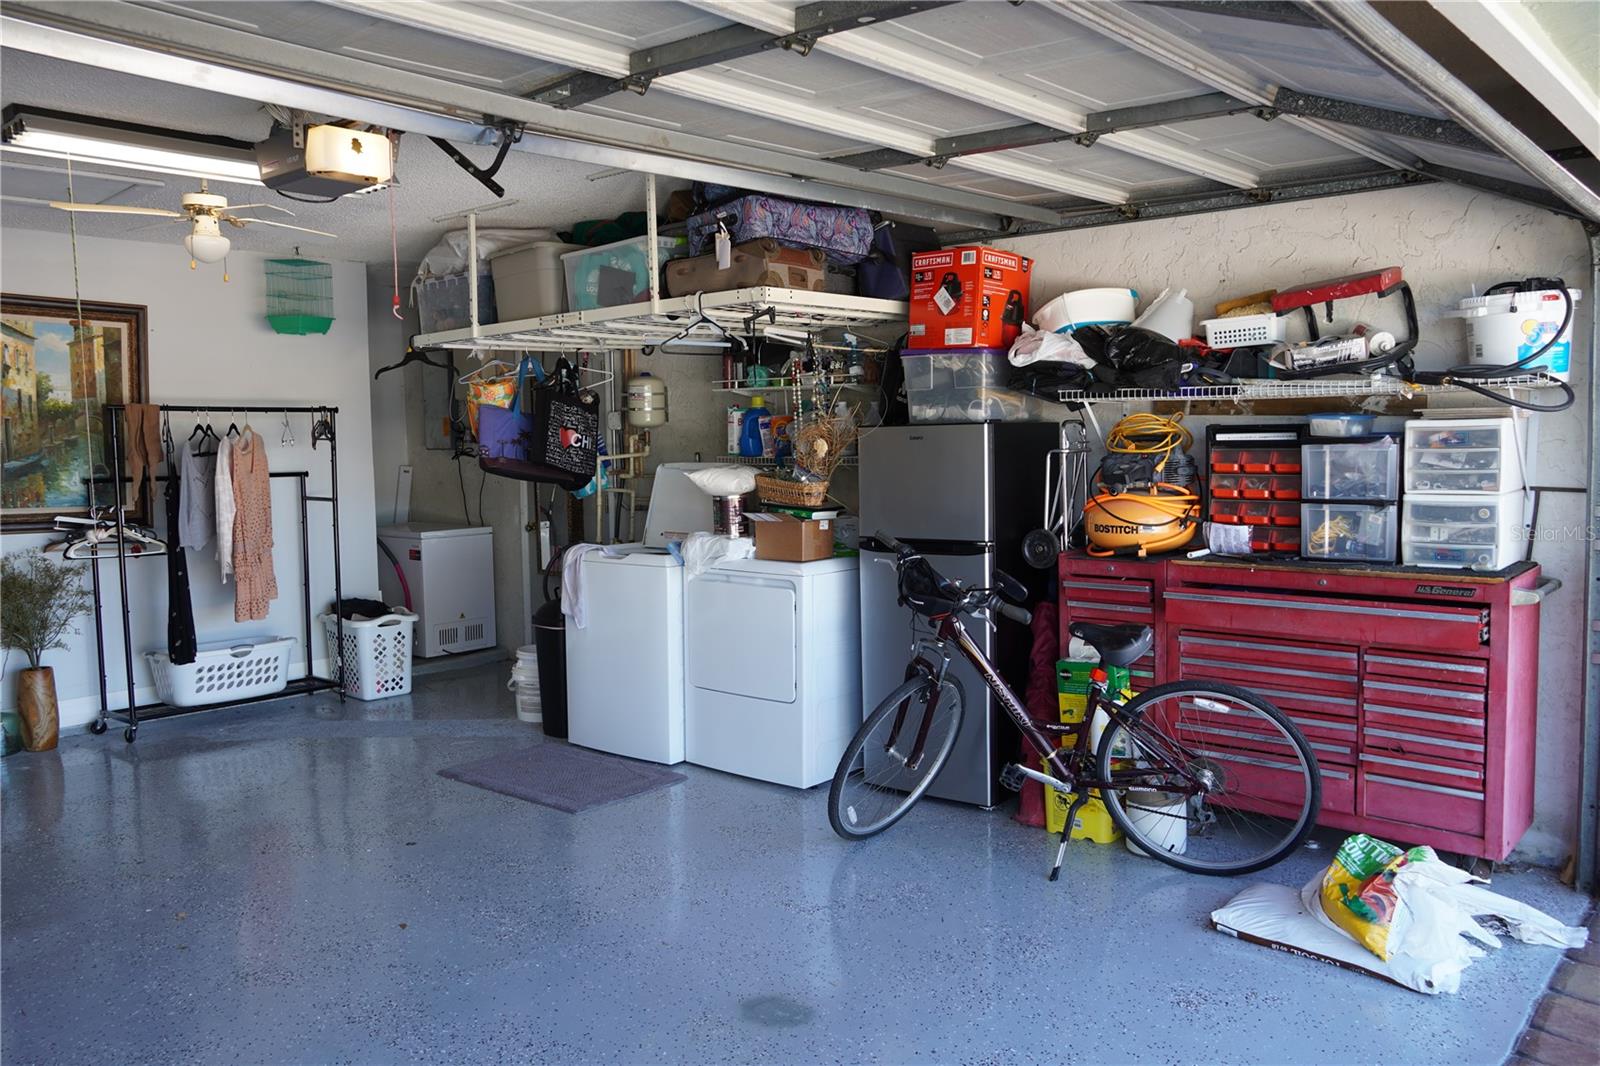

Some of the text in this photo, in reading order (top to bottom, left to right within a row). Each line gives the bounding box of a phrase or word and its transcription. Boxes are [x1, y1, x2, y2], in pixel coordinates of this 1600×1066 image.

[915, 256, 951, 267] CRAFTSMAN
[984, 254, 1016, 267] CRAFTSMAN
[1094, 524, 1139, 534] BOSTITCH
